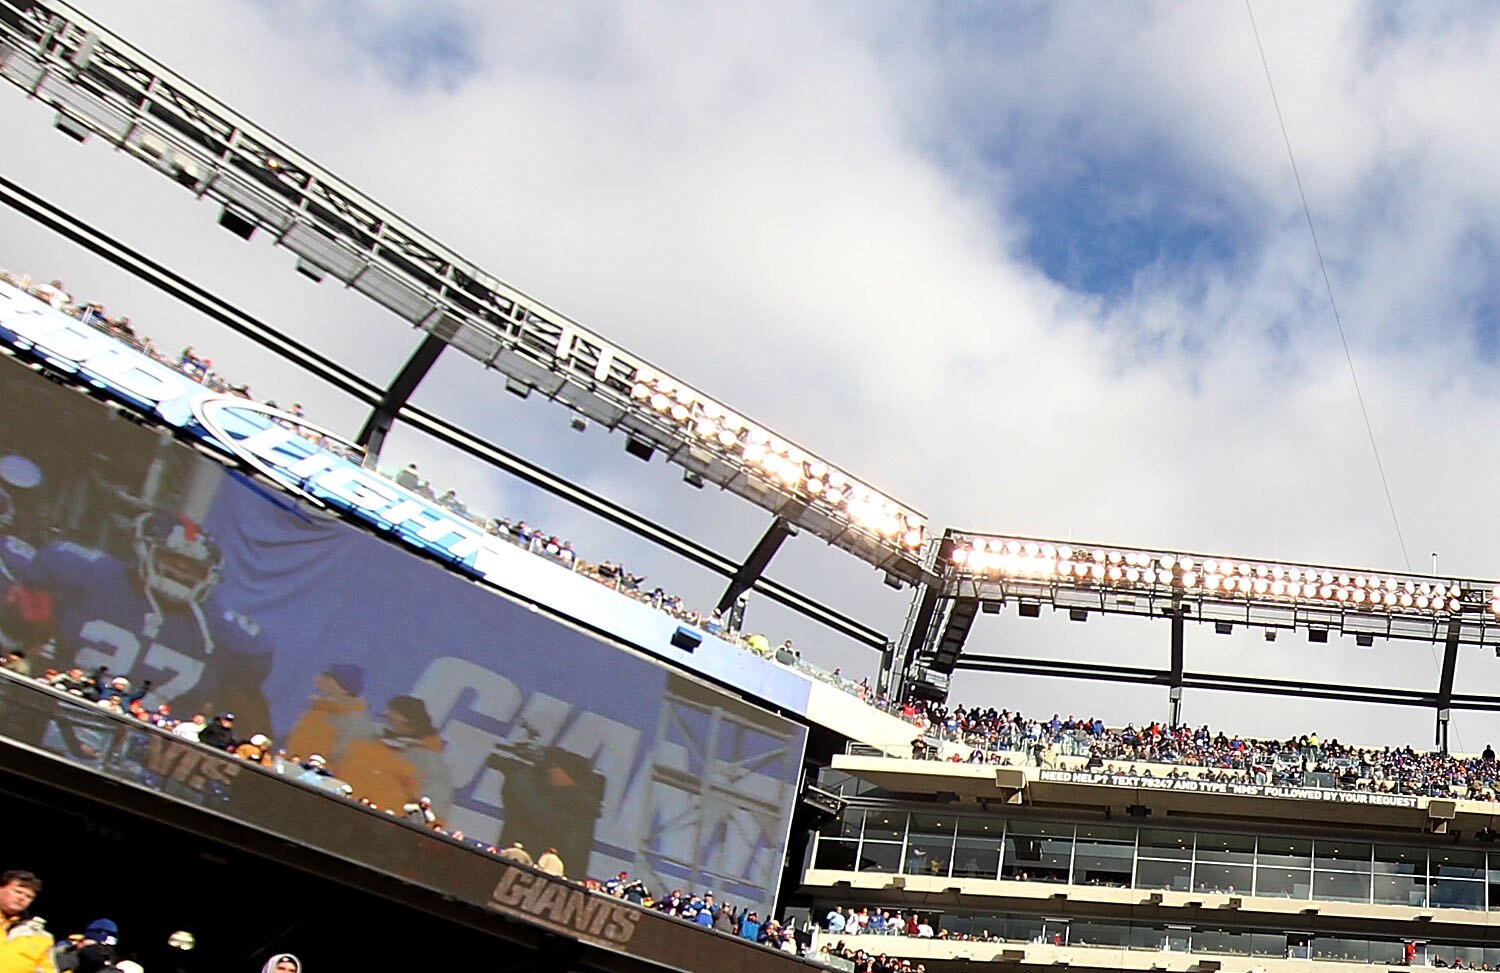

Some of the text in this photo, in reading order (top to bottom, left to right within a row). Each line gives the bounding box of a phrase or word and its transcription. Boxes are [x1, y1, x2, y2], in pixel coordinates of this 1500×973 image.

[1041, 771, 1072, 782] NEED
[1072, 773, 1109, 785] HELP?
[1112, 776, 1141, 788] TEXT
[1173, 780, 1199, 792] AND
[1199, 782, 1227, 793] TYPE
[1264, 786, 1322, 800] FOLLOWED
[1323, 791, 1338, 801] BY
[1338, 792, 1369, 804] YOUR
[1369, 794, 1417, 808] REQUEST
[492, 864, 643, 945] GIANTS
